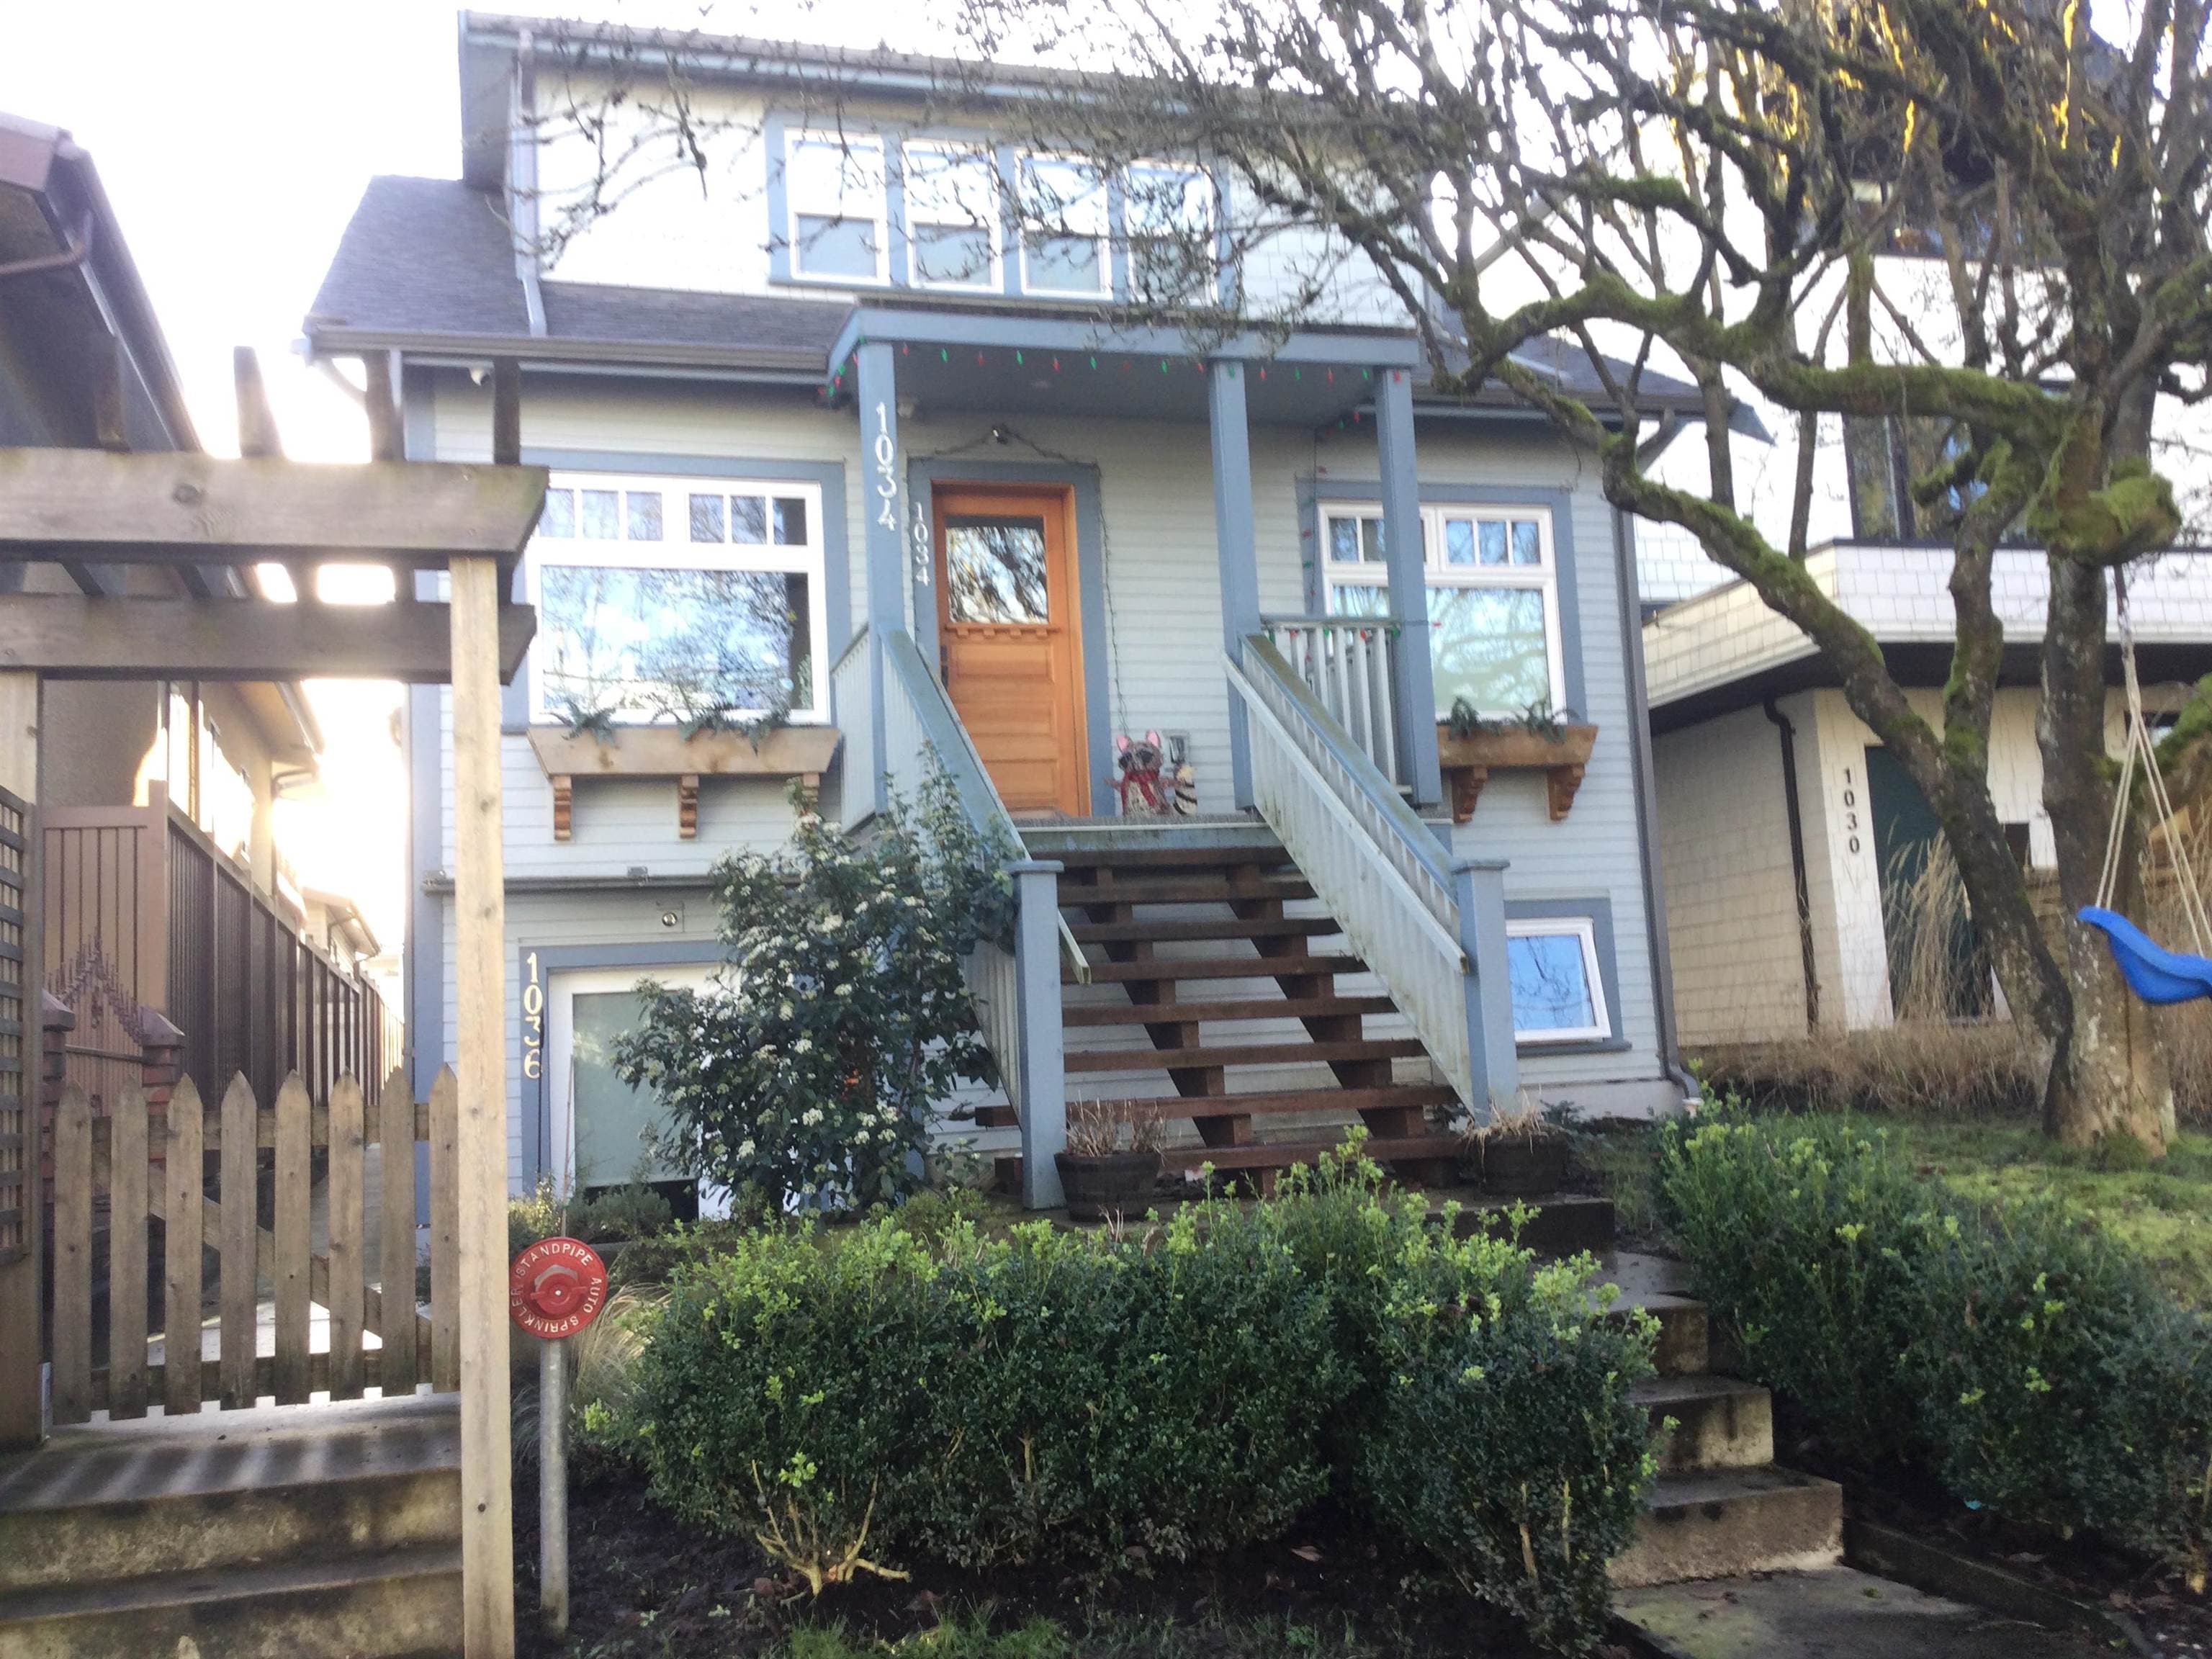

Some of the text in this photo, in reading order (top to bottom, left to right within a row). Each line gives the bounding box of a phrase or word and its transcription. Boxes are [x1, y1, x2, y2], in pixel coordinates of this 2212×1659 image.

[875, 402, 897, 531] 1034
[914, 502, 930, 586] 1034
[1843, 767, 1860, 854] 1030
[523, 952, 543, 1079] 1036
[516, 1243, 593, 1276] STANDPIPE
[511, 1277, 602, 1333] AUTO SPRINKLER
